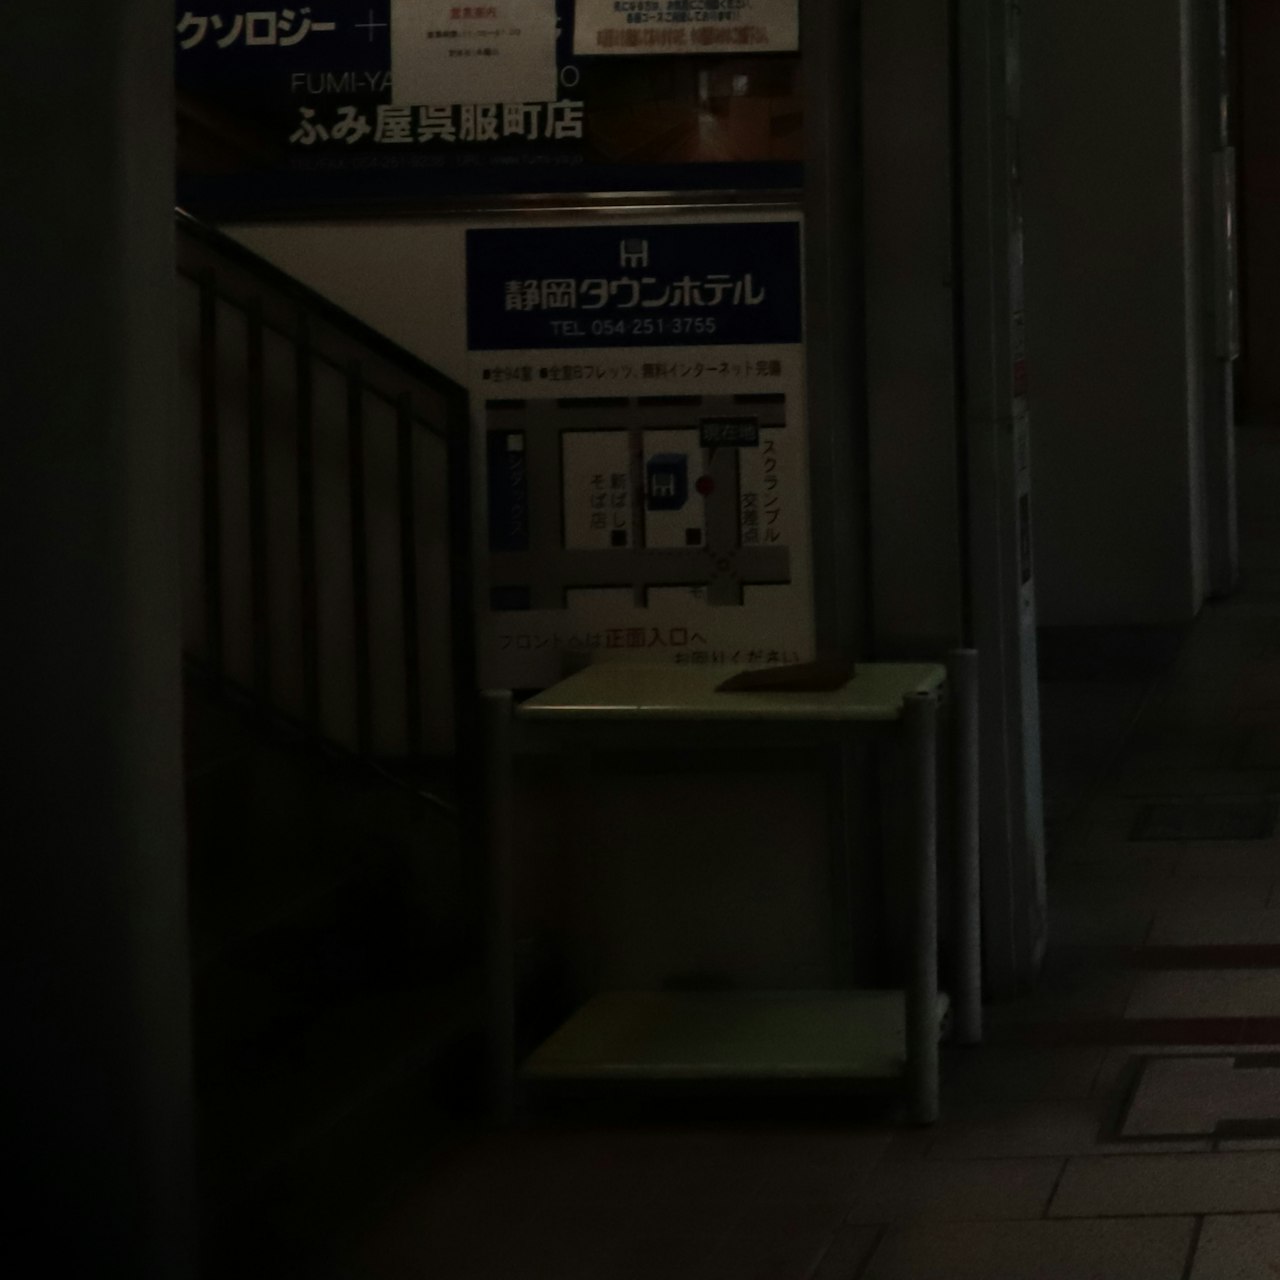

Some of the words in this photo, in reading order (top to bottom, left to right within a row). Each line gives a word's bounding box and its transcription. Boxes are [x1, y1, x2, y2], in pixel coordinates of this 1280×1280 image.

[288, 100, 586, 147] ふみ屋呉服町店
[504, 273, 767, 312] 静岡タウンホテル
[550, 320, 586, 337] TEL
[762, 439, 781, 543] スクランブル
